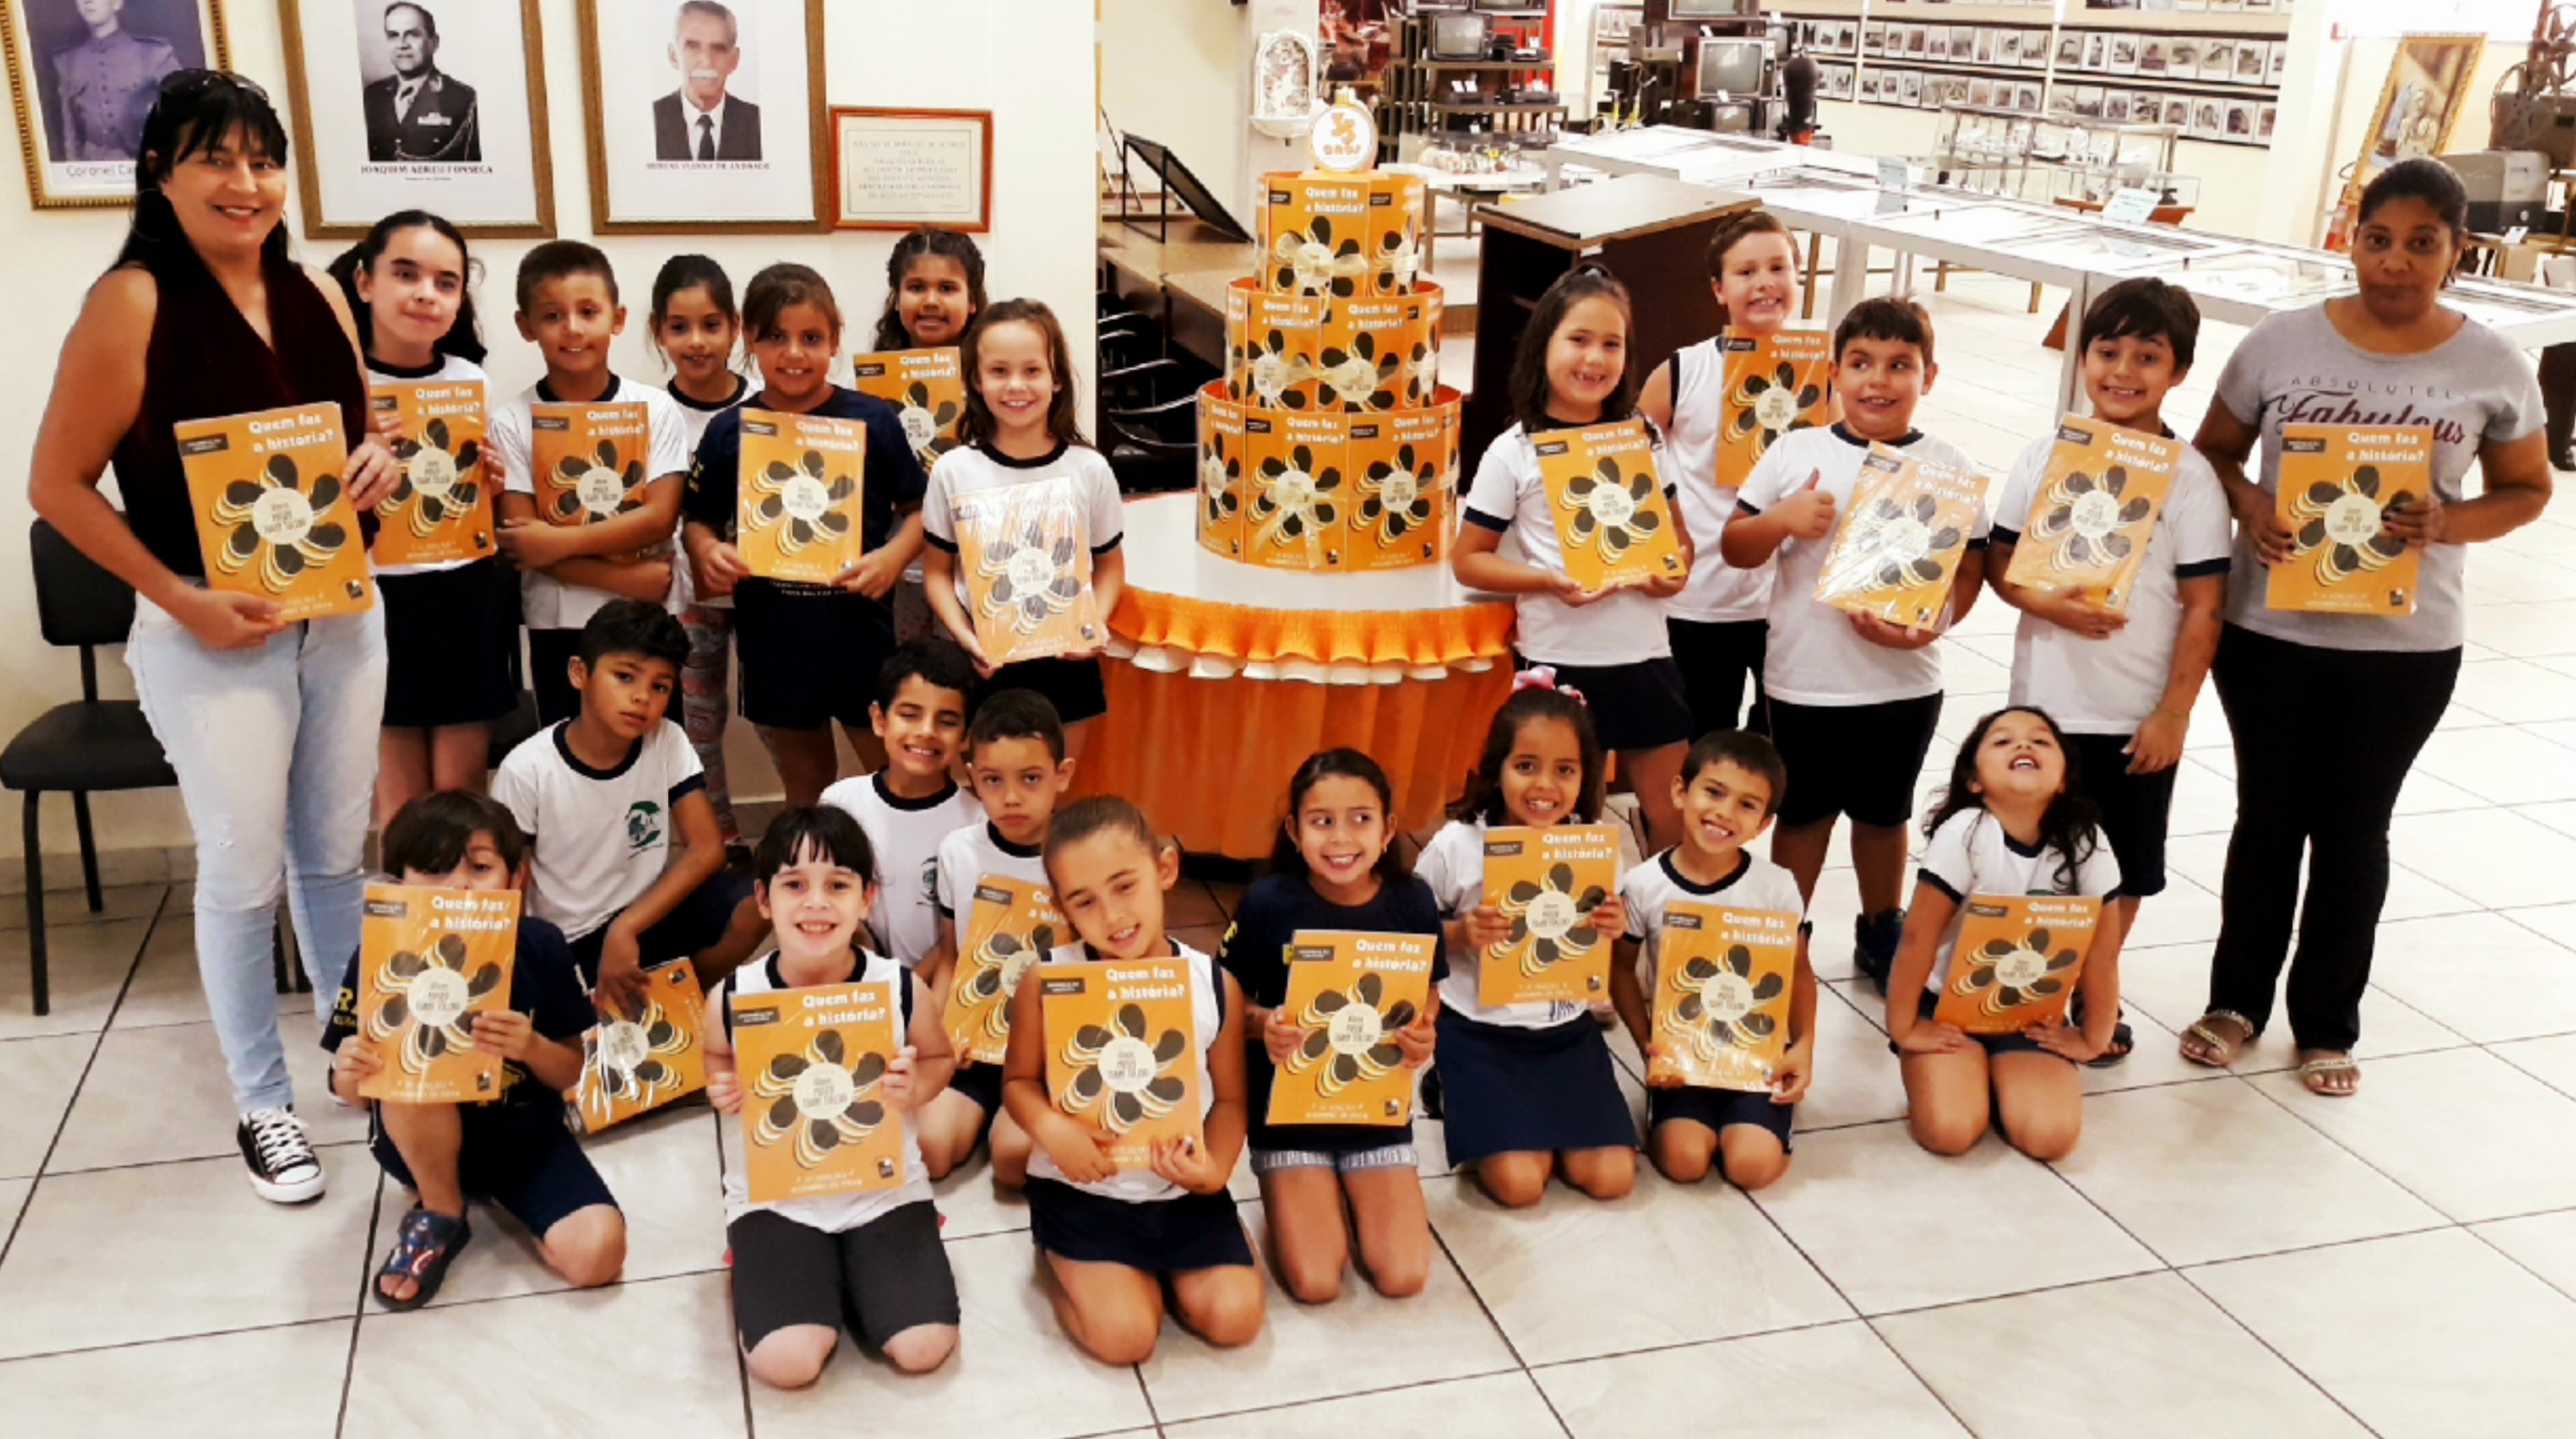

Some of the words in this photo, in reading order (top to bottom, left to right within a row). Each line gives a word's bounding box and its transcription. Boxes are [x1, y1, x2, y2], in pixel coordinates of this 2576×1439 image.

[66, 165, 116, 177] Coronel
[360, 165, 408, 175] JOAQUIM
[447, 165, 493, 175] FONSECA
[1305, 187, 1338, 199] Quem
[1341, 187, 1358, 199] faz
[1305, 204, 1311, 213] a
[1262, 300, 1291, 313] Quem
[1348, 304, 1381, 315] Quem
[1383, 303, 1398, 314] faz
[1348, 320, 1355, 329] a
[1771, 334, 1803, 345] Quem
[900, 356, 931, 365] Quem
[415, 386, 452, 401] Quem
[454, 385, 473, 397] faz
[416, 403, 425, 416] a
[586, 410, 620, 422] Quem
[248, 416, 295, 435] Quem
[299, 412, 323, 428] faz
[795, 421, 832, 435] Quem
[1287, 416, 1320, 429] Quem
[1322, 418, 1339, 430] faz
[1394, 417, 1420, 429] Quem
[1287, 433, 1293, 442] a
[1582, 429, 1615, 442] Quem
[2347, 432, 2392, 445] Quem
[2396, 432, 2419, 445] faz
[253, 441, 265, 454] a
[2111, 432, 2147, 450] Quem
[2148, 441, 2167, 456] faz
[2105, 449, 2114, 458] a
[2347, 452, 2355, 461] a
[1542, 833, 1581, 845] Quem
[1585, 832, 1605, 843] faz
[1542, 851, 1550, 860] a
[431, 895, 480, 911] Quem
[481, 897, 505, 912] faz
[2028, 901, 2066, 913] Quem
[429, 919, 440, 930] a
[1723, 912, 1761, 927] Quem
[1765, 916, 1787, 929] faz
[1721, 931, 1729, 939] a
[1356, 939, 1396, 952] Quem
[1401, 940, 1422, 954] faz
[1352, 959, 1362, 968] a
[1106, 969, 1150, 983] Quem
[1153, 967, 1175, 979] faz
[802, 992, 849, 1010] Quem
[853, 990, 877, 1003] faz
[1108, 991, 1117, 1001] a
[804, 1016, 814, 1028] a
